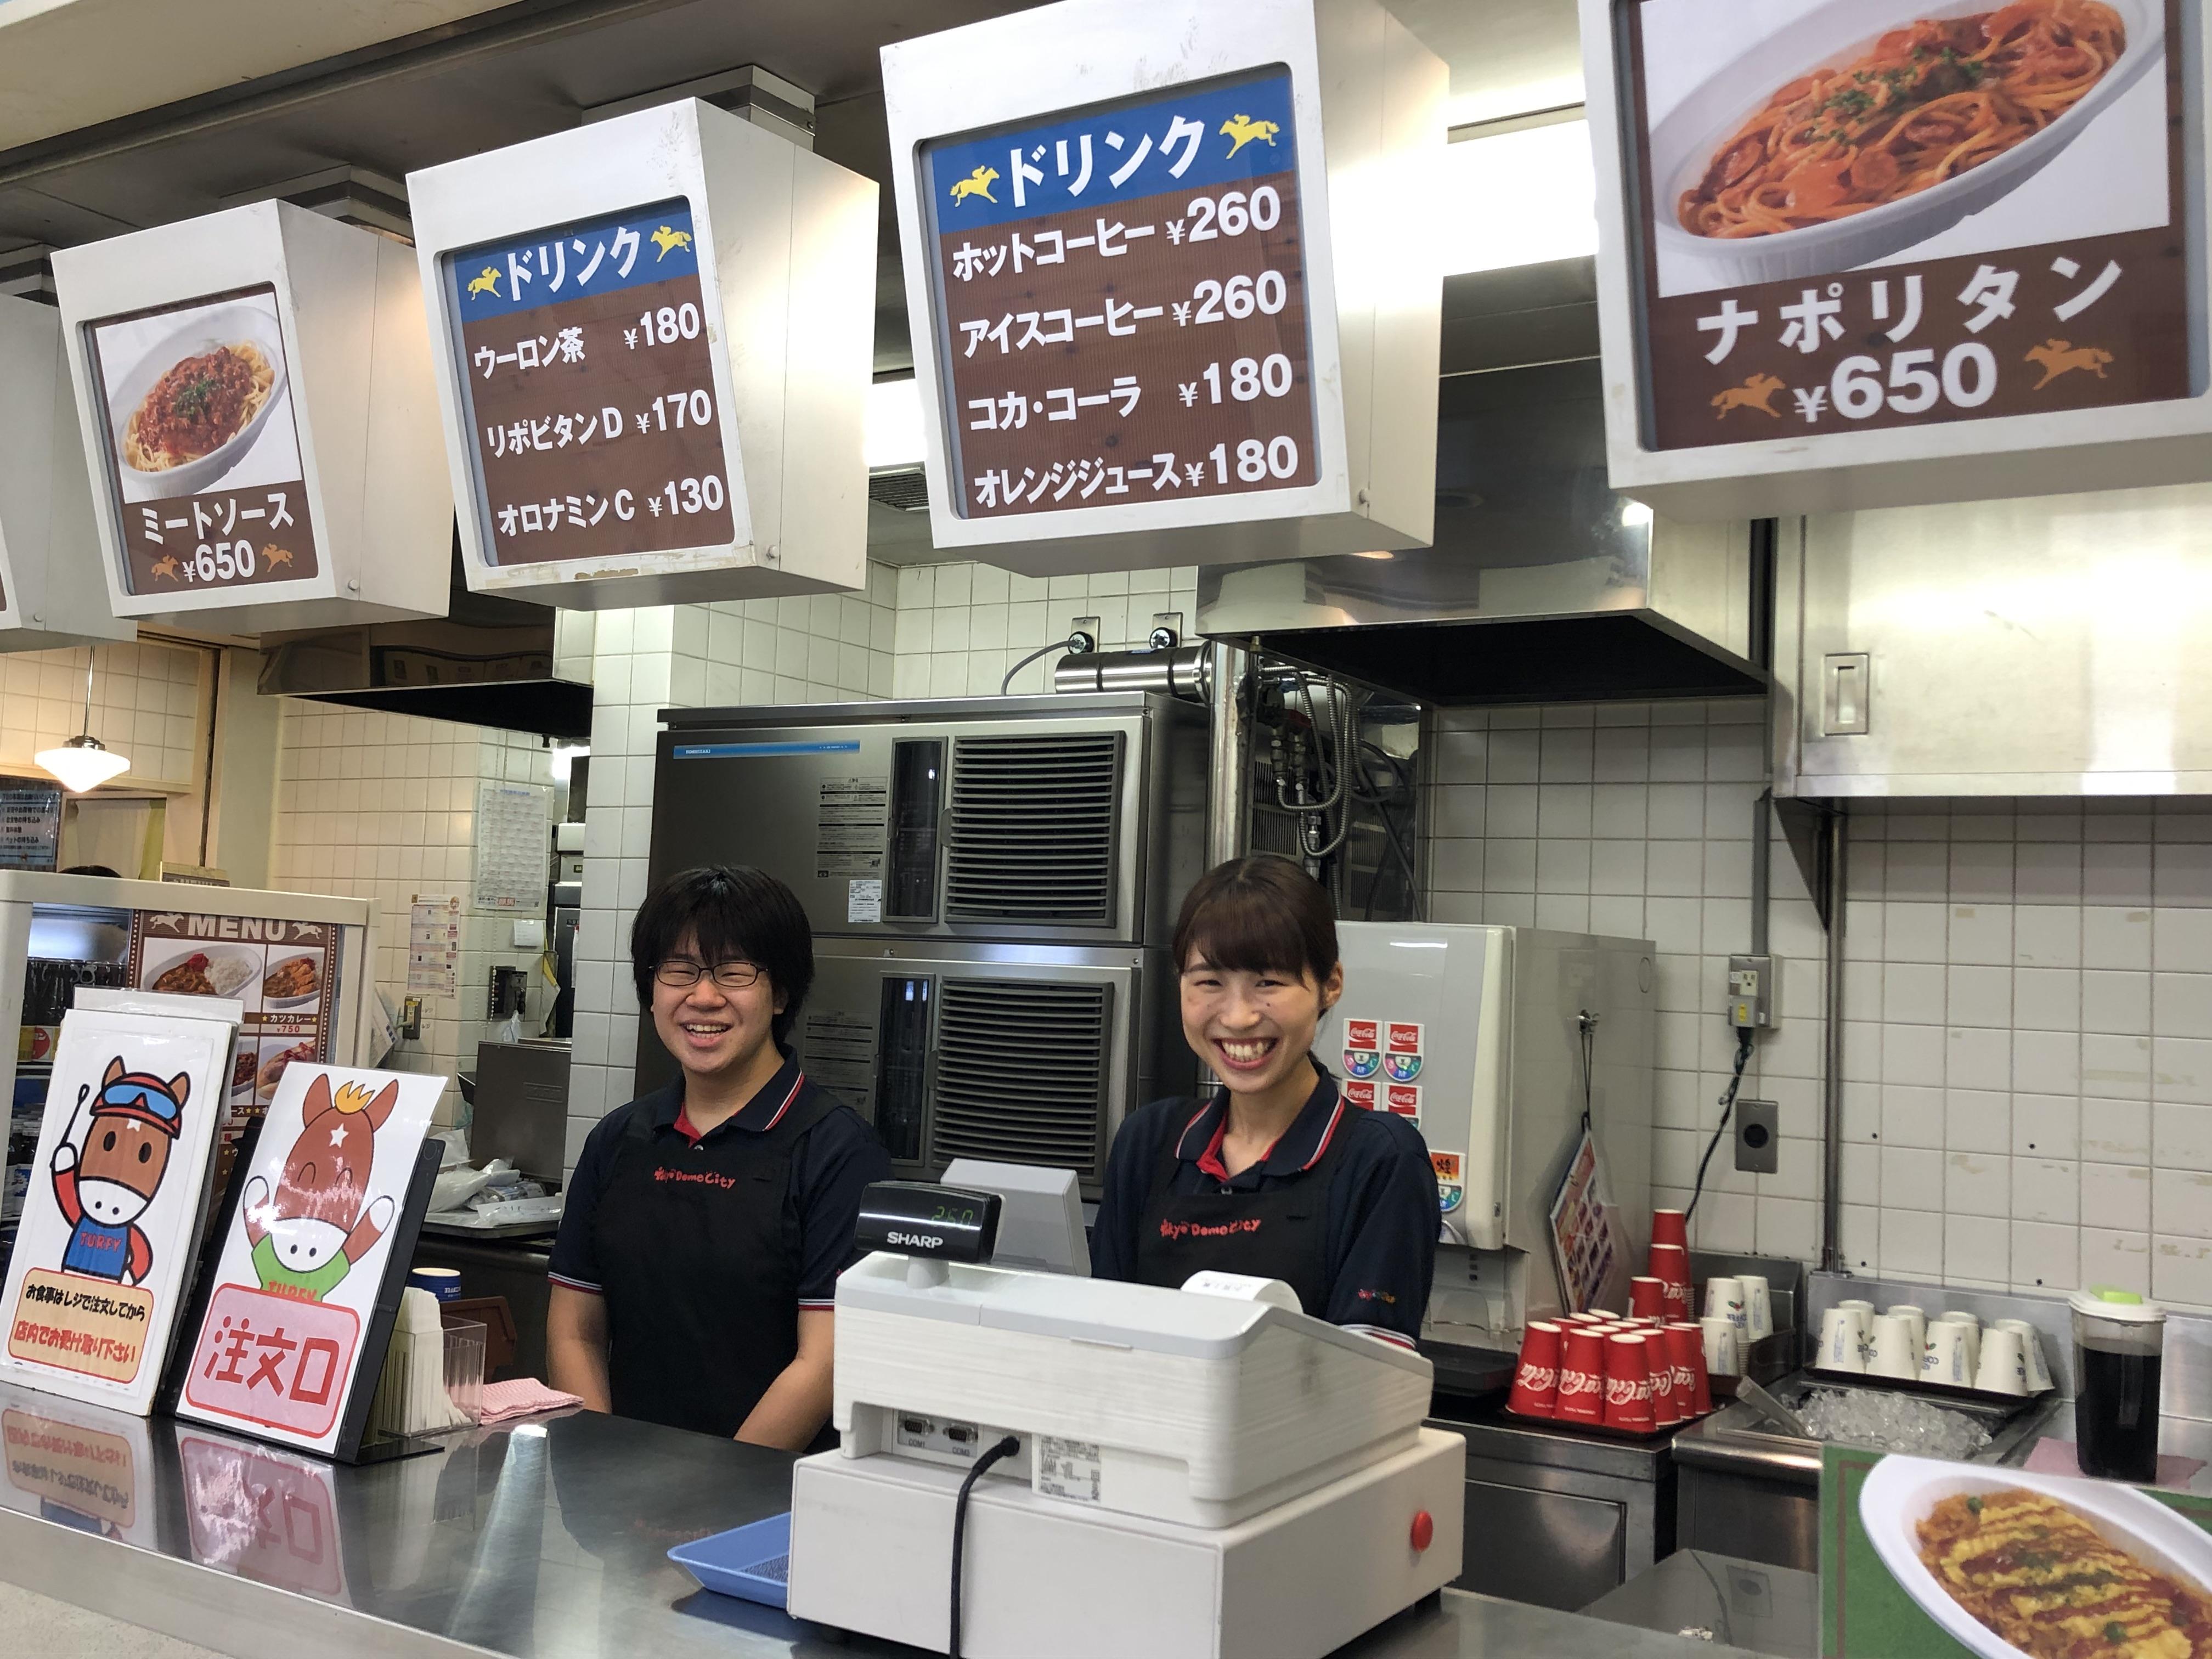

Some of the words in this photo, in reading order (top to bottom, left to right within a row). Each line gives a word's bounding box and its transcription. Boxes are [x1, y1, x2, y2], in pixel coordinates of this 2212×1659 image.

[1011, 115, 1205, 208] ドリンク
[506, 226, 641, 301] ドリンク
[952, 219, 1155, 281] ホットコーヒー
[1166, 185, 1280, 246] ¥260
[474, 327, 585, 379] ウーロン茶
[623, 303, 699, 350] ¥180
[959, 298, 1163, 358] アイスコーヒー
[1172, 270, 1286, 328] ¥260
[1697, 256, 2122, 365] ナポリタン
[636, 390, 712, 434] ¥170
[968, 376, 1142, 430] コカ・コーラ
[1178, 353, 1293, 408] ¥180
[1792, 342, 1997, 422] ¥650
[648, 475, 724, 517] ¥130
[975, 452, 1182, 507] オレンジジュース
[1185, 436, 1298, 487] ¥180
[142, 492, 294, 545] ミートソース
[182, 540, 256, 583] ¥650
[188, 913, 286, 941] MENU
[270, 1014, 311, 1023] カツカレー
[80, 1232, 122, 1252] TURFY
[887, 1231, 944, 1249] SHARP
[26, 1284, 145, 1322] お食事はレジで注文してから
[14, 1321, 136, 1363] 店内でお受け取り下さい
[204, 1316, 340, 1405] 注文口
